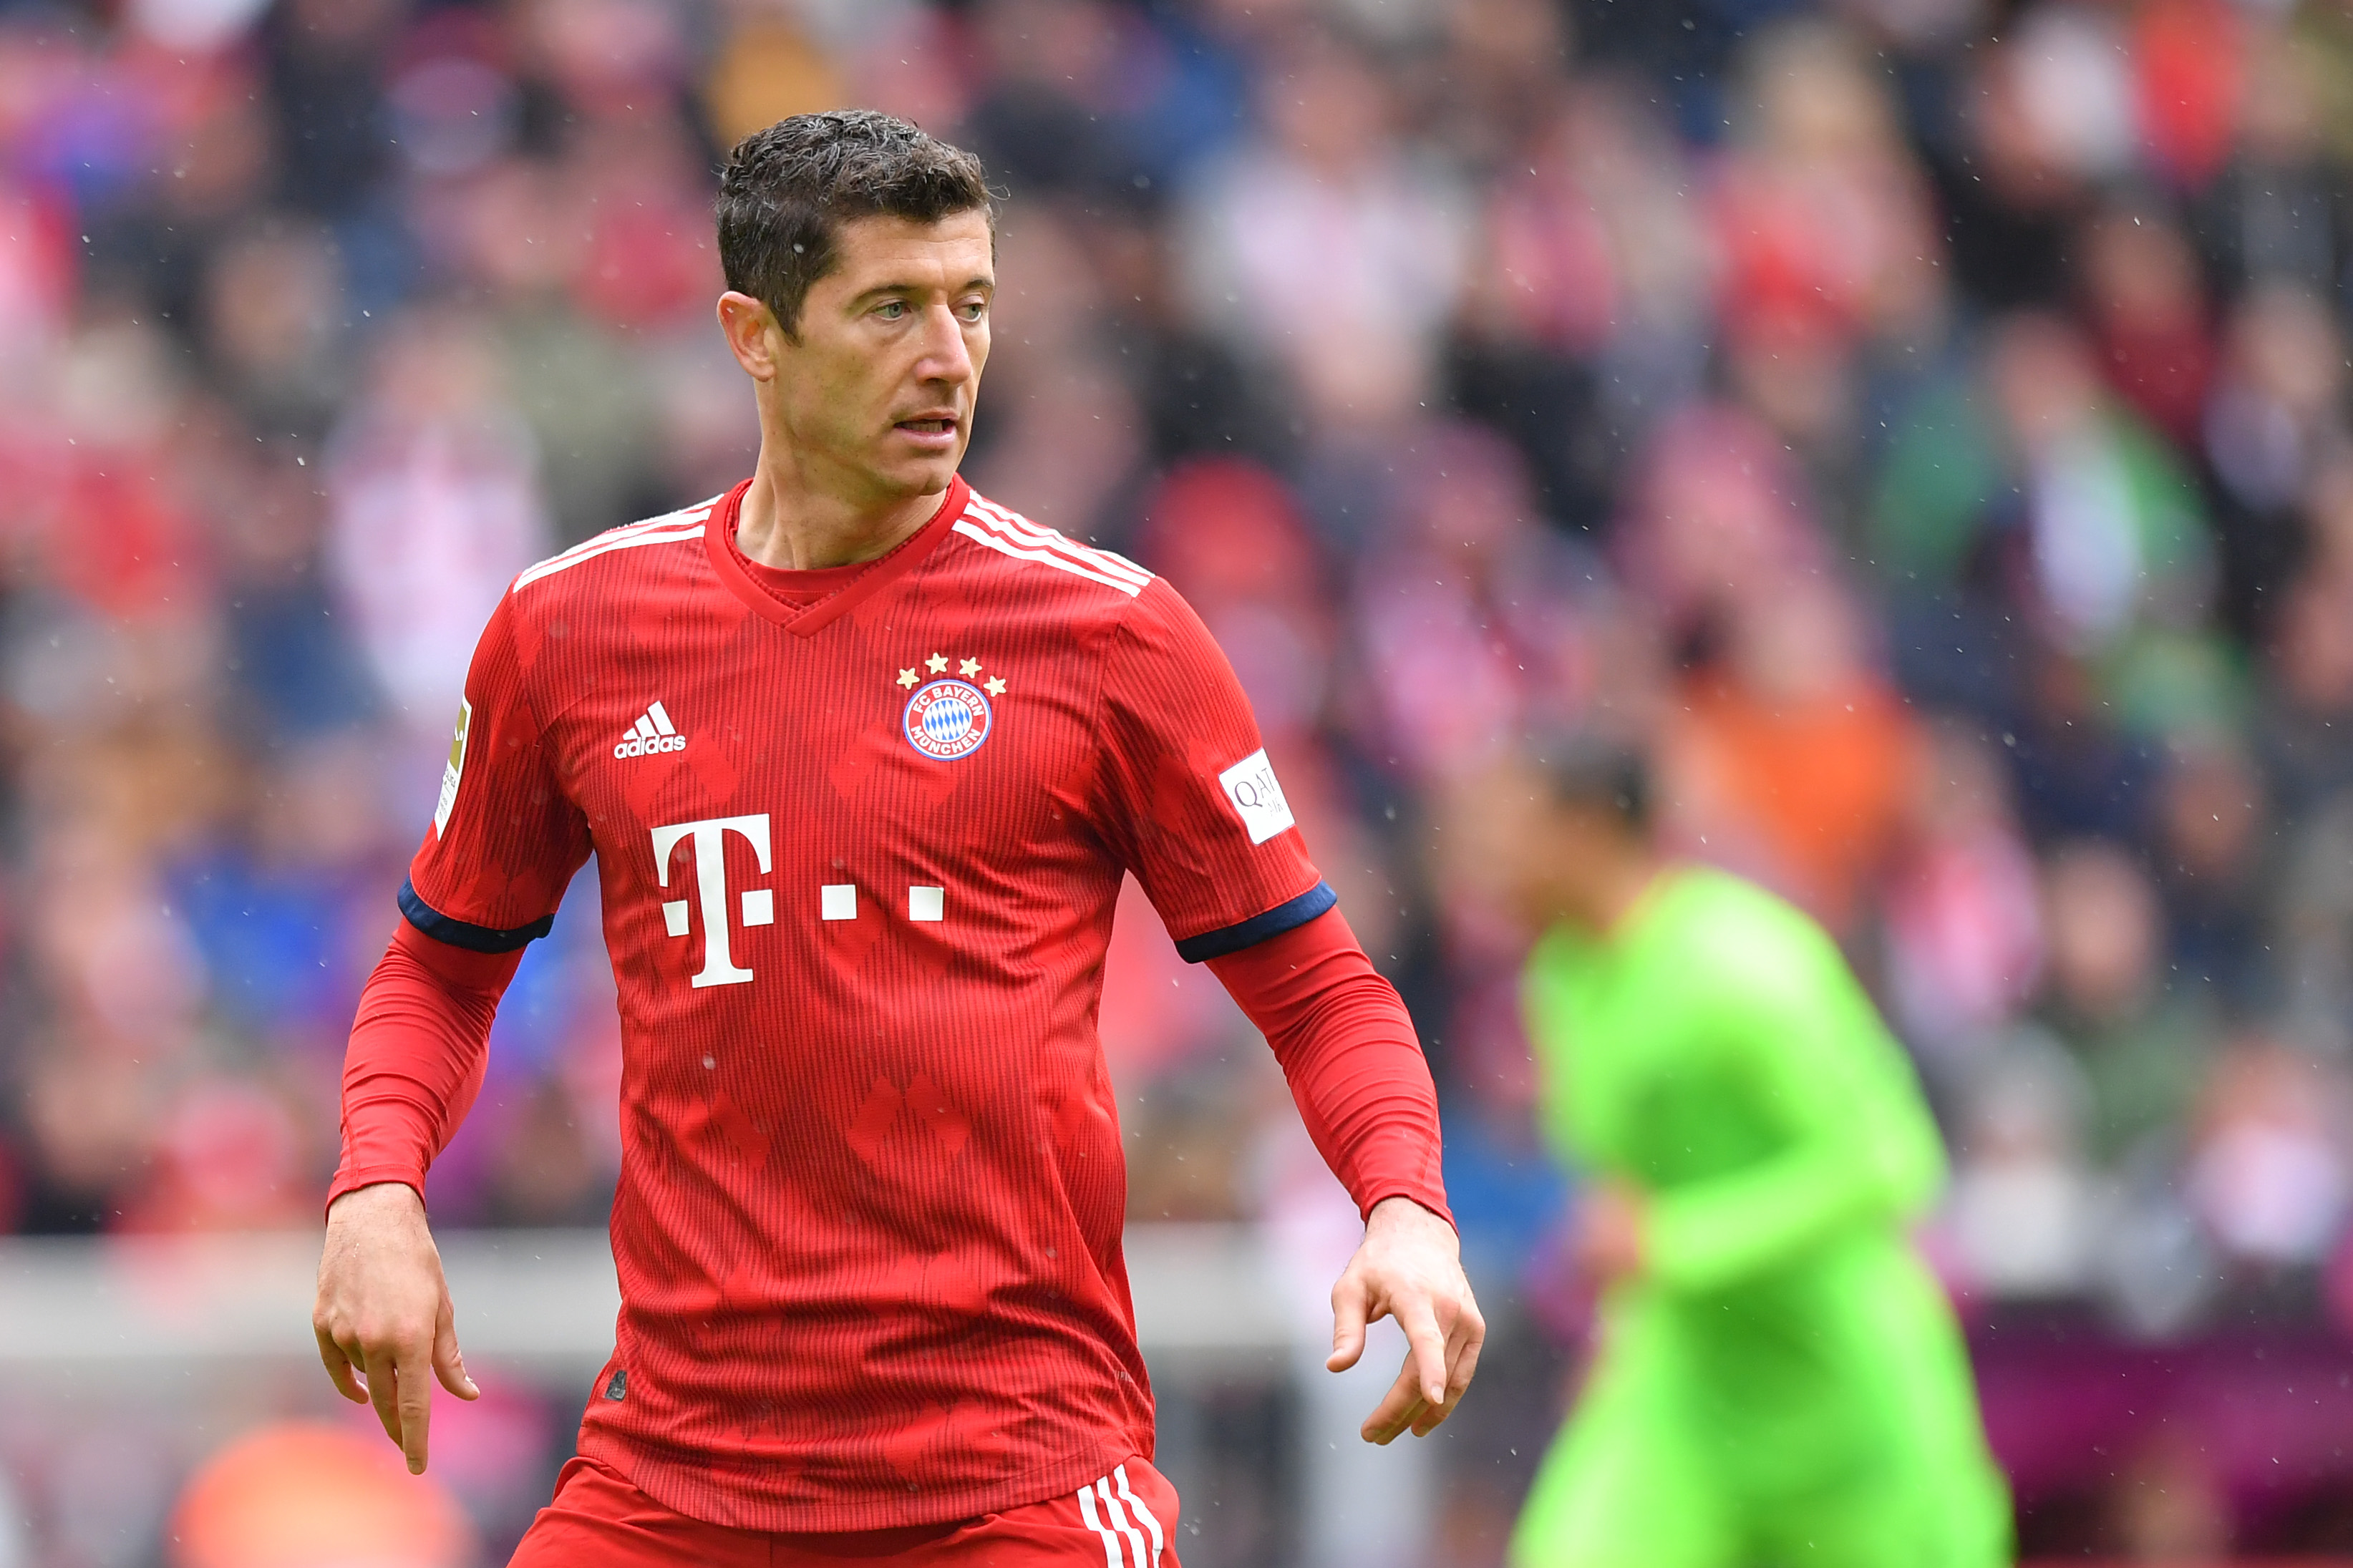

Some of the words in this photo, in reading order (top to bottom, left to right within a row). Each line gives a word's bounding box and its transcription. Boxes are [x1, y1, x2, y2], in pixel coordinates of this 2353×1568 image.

[913, 695, 931, 714] FC
[932, 686, 984, 716] BAYERN
[614, 734, 687, 759] adidas
